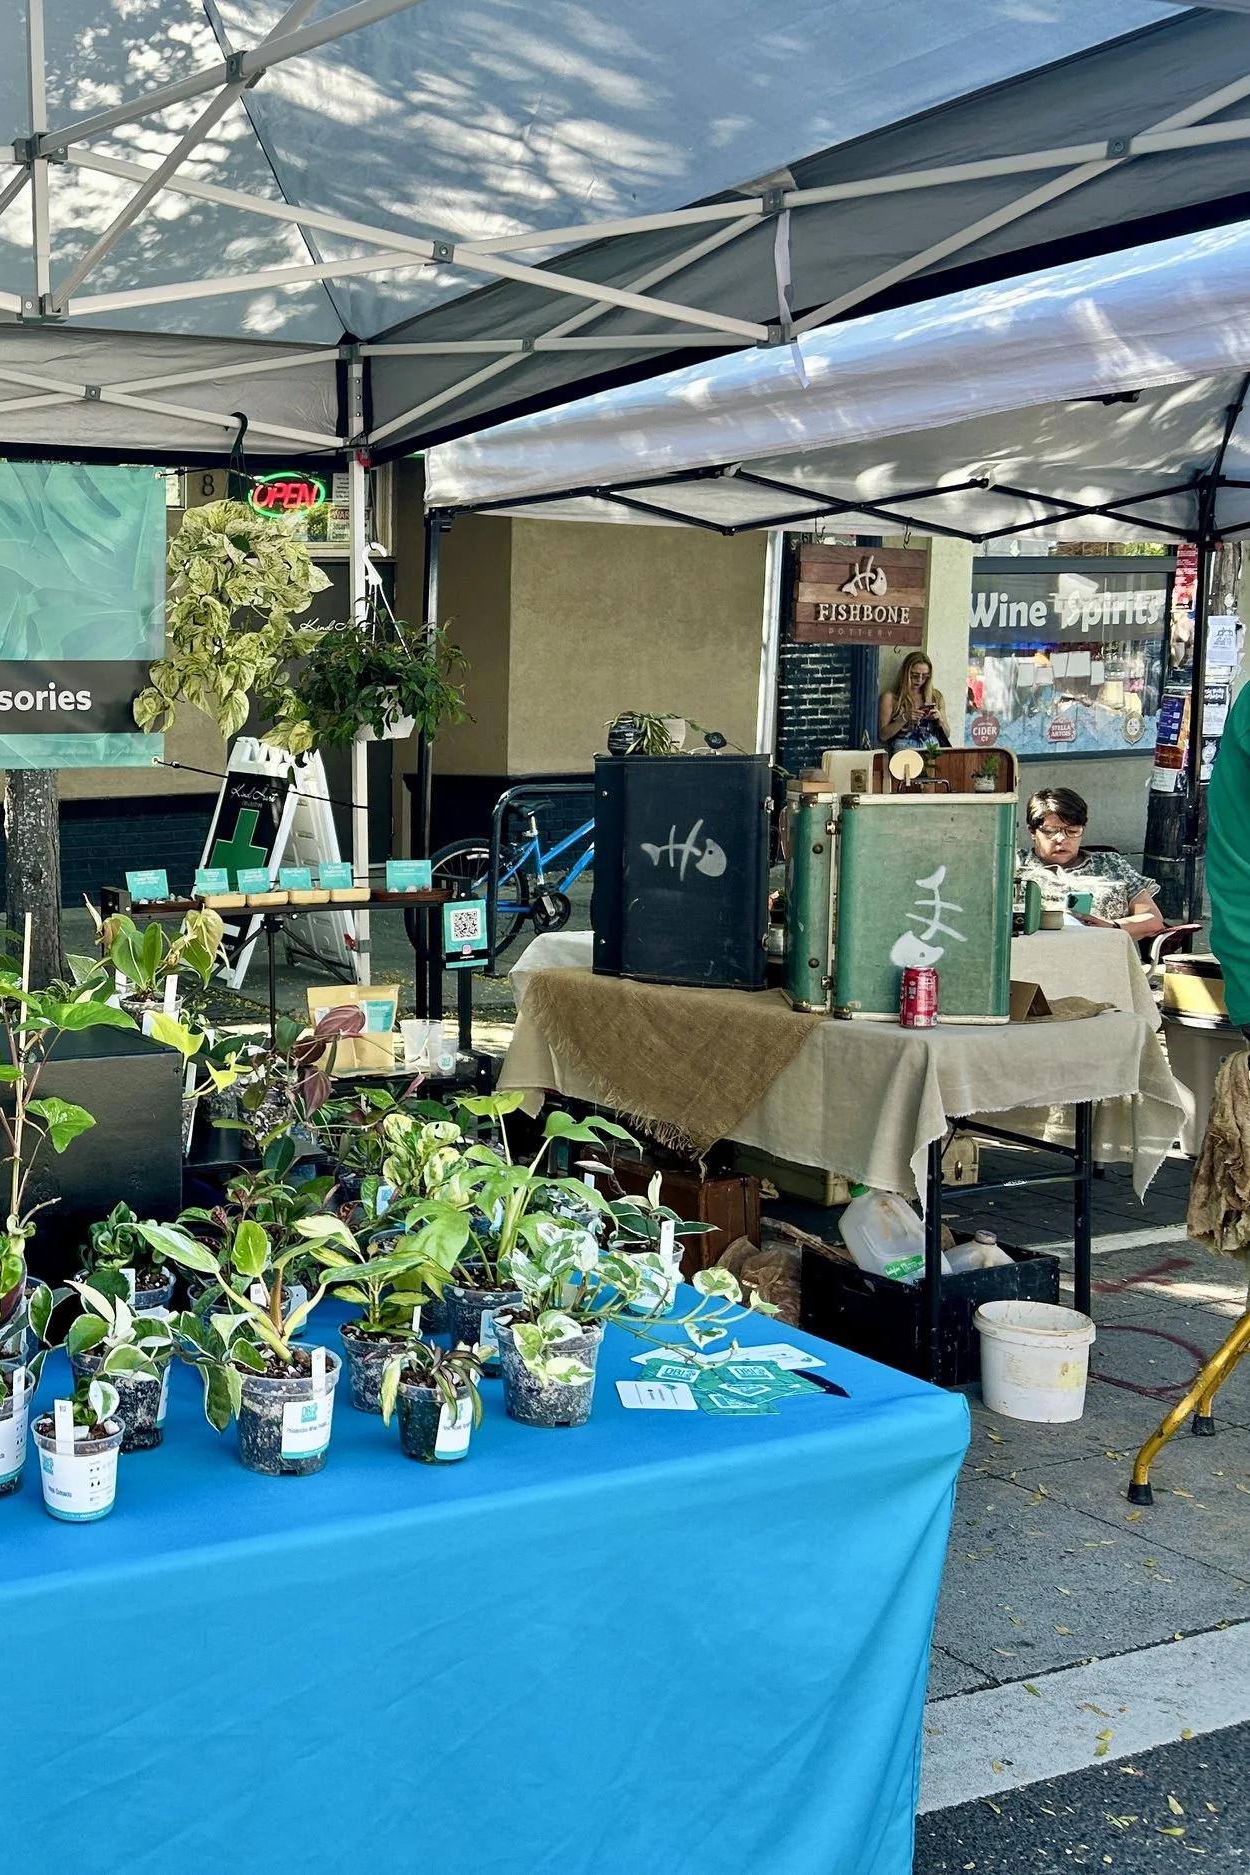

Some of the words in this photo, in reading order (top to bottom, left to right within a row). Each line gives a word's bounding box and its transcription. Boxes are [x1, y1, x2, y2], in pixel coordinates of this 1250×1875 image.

[201, 474, 215, 496] 8
[252, 482, 318, 509] OPEN
[817, 603, 910, 625] FISHBONE
[970, 592, 1048, 628] Wine
[1061, 590, 1160, 632] Spirits
[300, 617, 335, 632] Kind
[828, 627, 893, 637] POTTERY
[972, 726, 997, 736] CIDER
